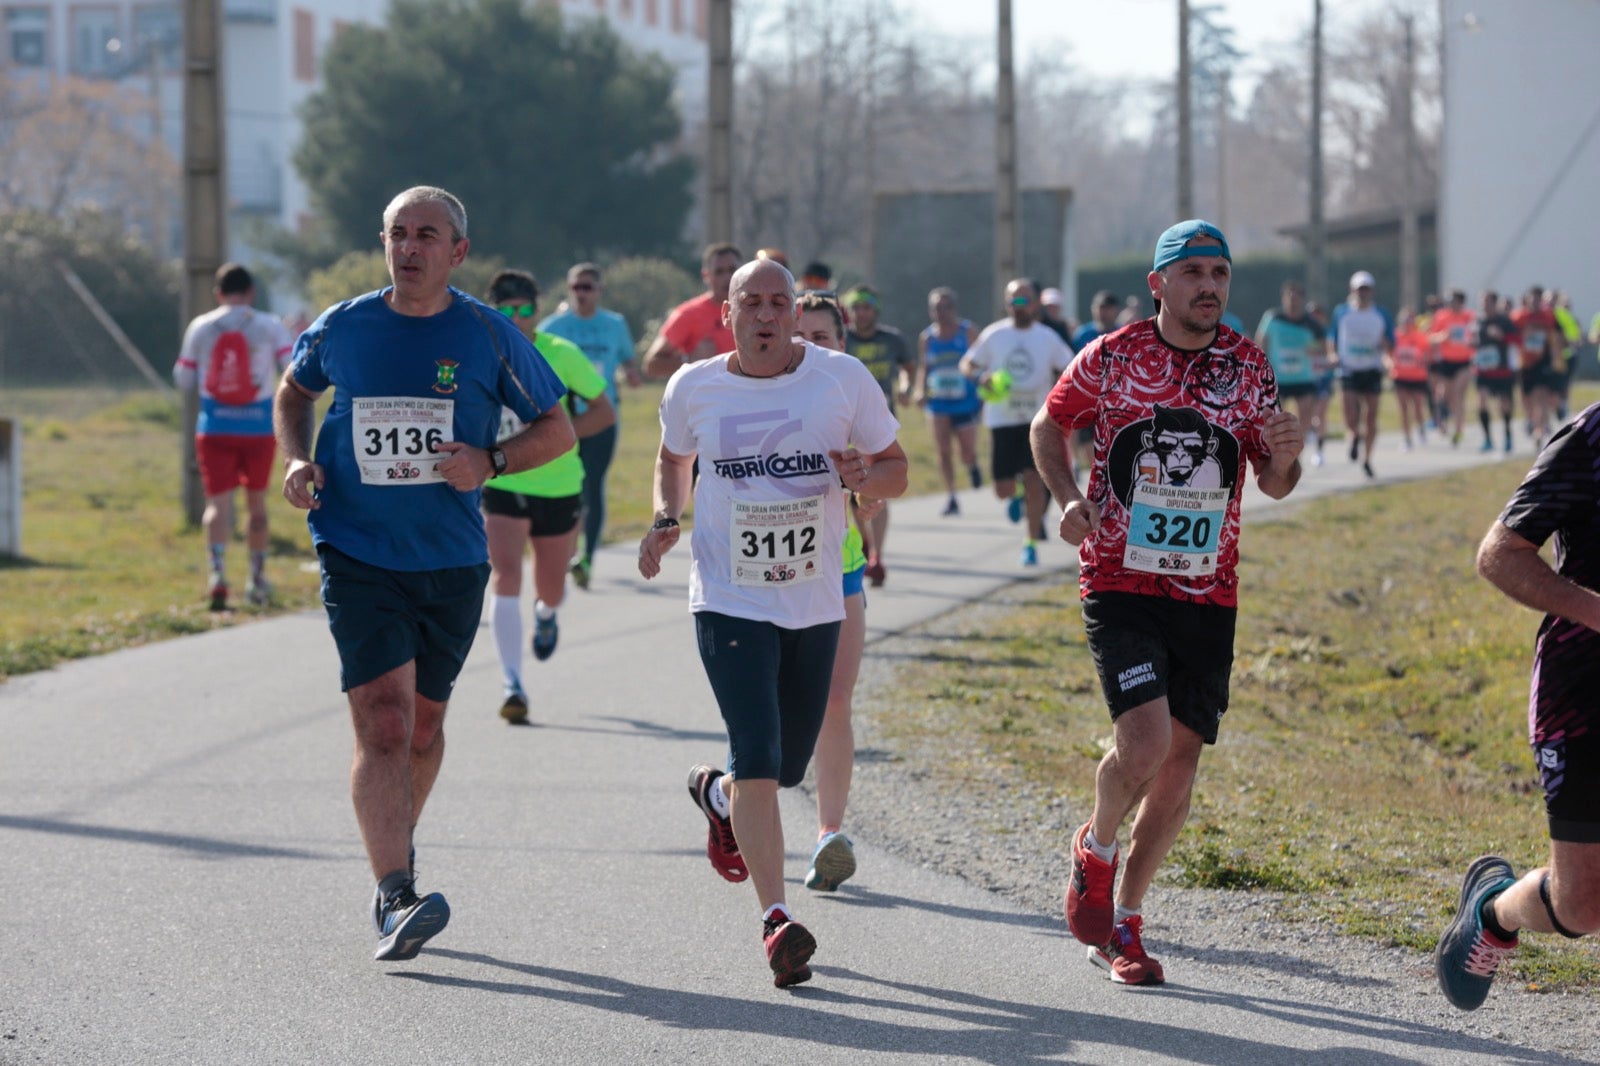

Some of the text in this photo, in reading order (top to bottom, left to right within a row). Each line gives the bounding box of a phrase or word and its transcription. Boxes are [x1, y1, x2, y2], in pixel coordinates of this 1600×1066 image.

[426, 402, 447, 410] FONDO
[364, 427, 444, 456] 3136
[1159, 488, 1176, 498] GRAN
[1177, 490, 1200, 500] PREMIO
[1200, 491, 1209, 500] DE
[751, 505, 768, 513] GRAN
[769, 503, 790, 513] PREMIO
[791, 503, 799, 511] DE
[800, 500, 818, 509] FONDO
[1145, 512, 1211, 548] 320
[741, 526, 816, 559] 3112
[1118, 662, 1152, 683] MONKEY
[1120, 672, 1156, 692] RUNNERS
